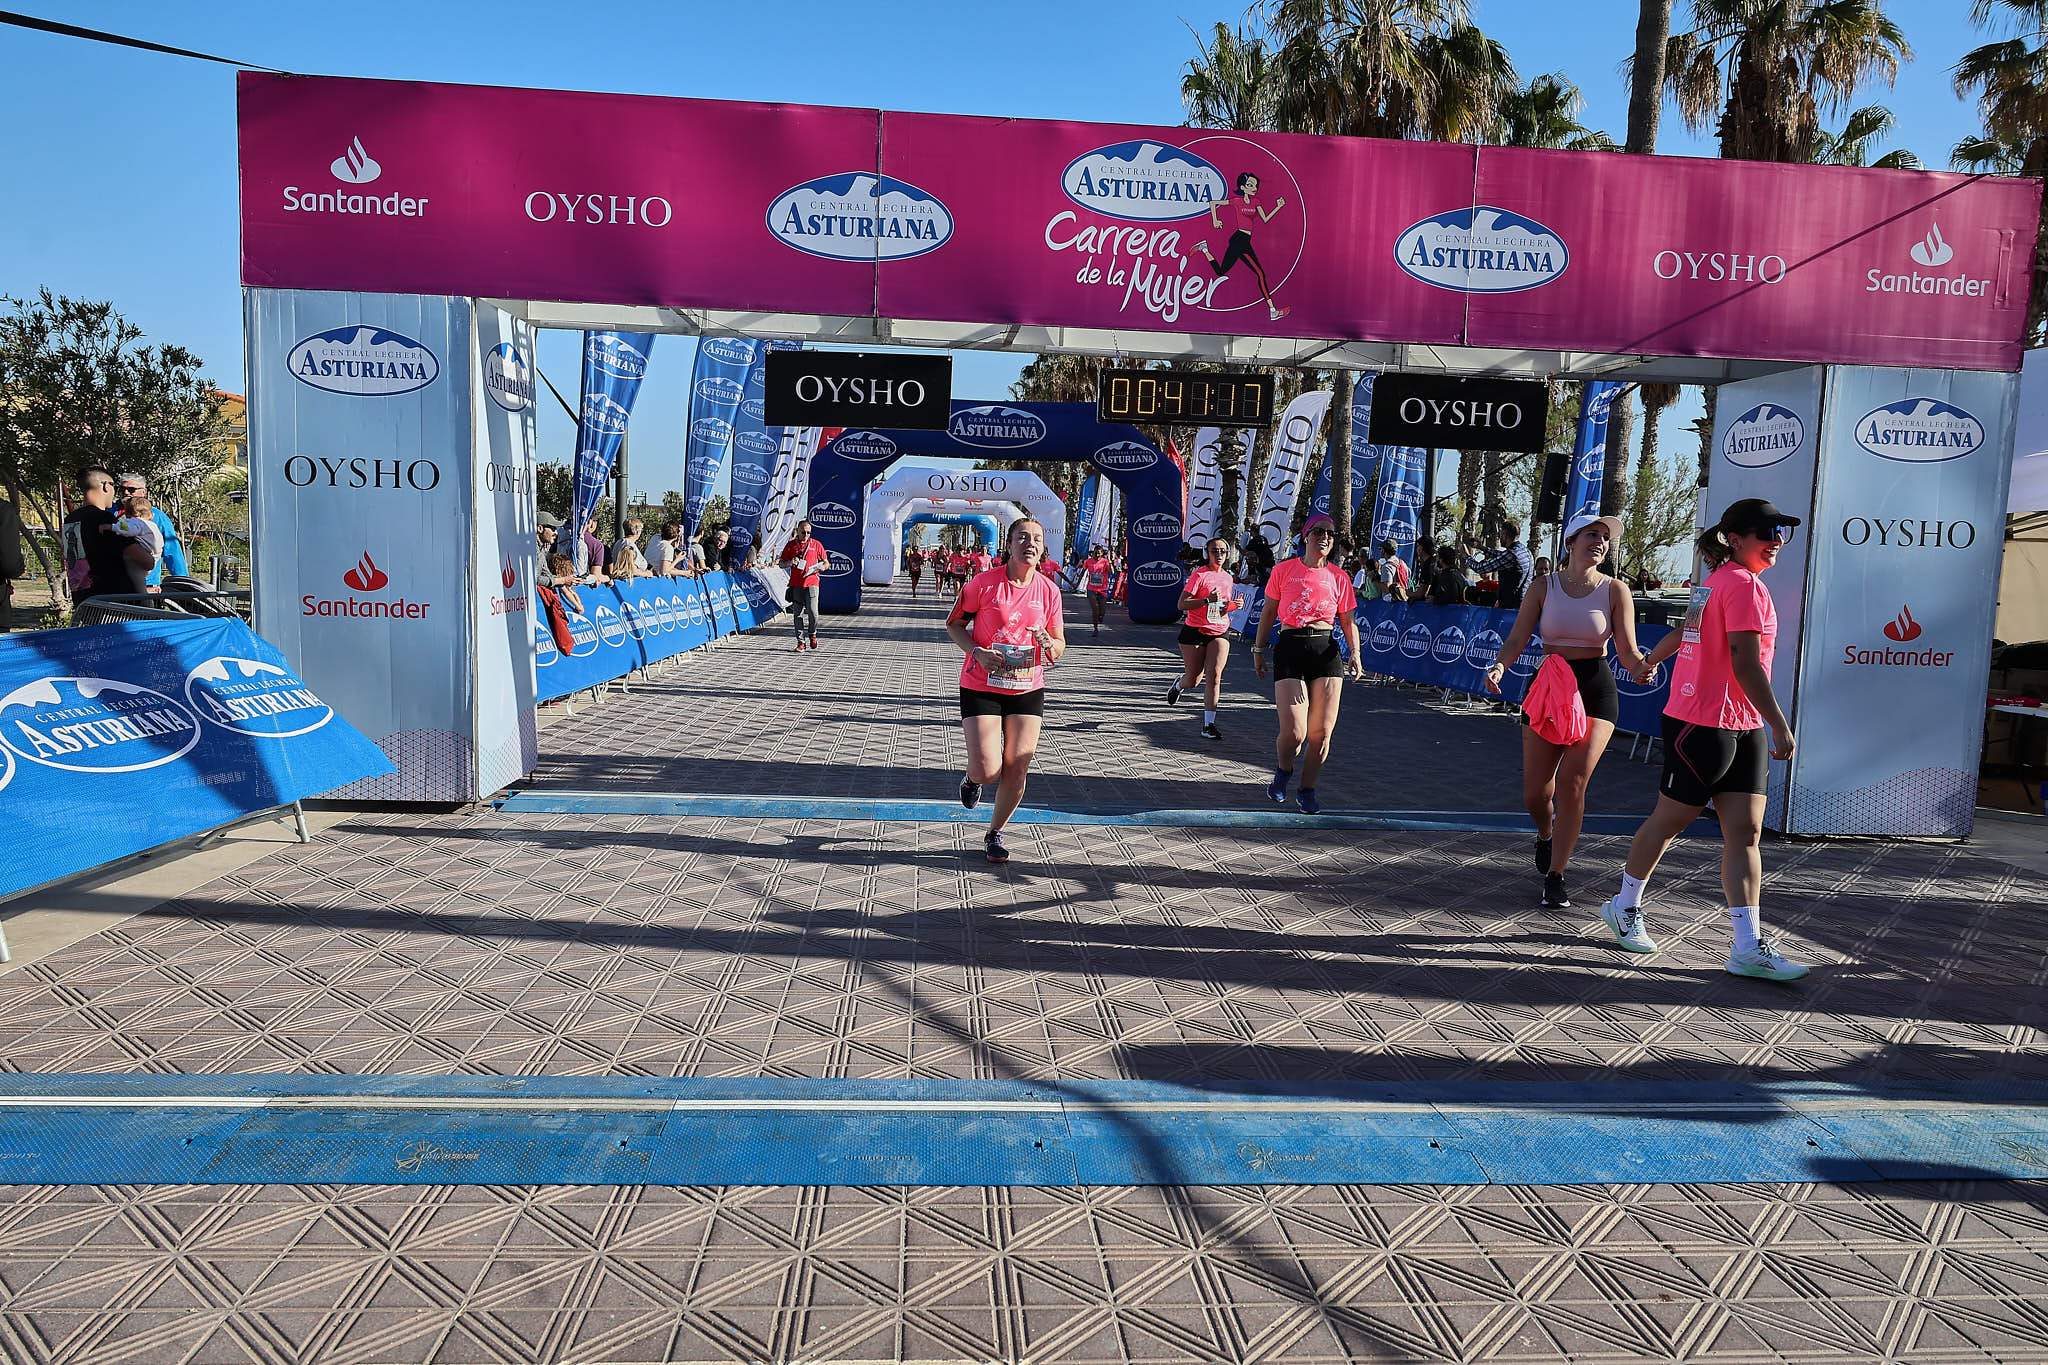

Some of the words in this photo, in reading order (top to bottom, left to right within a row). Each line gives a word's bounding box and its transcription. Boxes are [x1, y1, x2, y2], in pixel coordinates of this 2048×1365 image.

[1074, 166, 1213, 203] ASTURIANA
[1100, 165, 1152, 177] CENTRAL
[1157, 168, 1211, 180] LECHERA
[283, 185, 429, 218] Santander
[525, 191, 672, 227] OYSHO
[810, 201, 869, 212] CENTRAL
[781, 202, 939, 240] ASTURIANA
[1045, 210, 1182, 259] Carrera
[1407, 235, 1555, 273] ASTURIANA
[1435, 234, 1490, 245] CENTRAL
[1495, 237, 1551, 248] LECHERA
[1653, 249, 1787, 285] OYSHO
[1076, 256, 1102, 285] de
[1107, 256, 1125, 286] la
[1119, 255, 1229, 323] Mujer
[1865, 268, 1991, 298] Santander
[299, 350, 428, 380] ASTURIANA
[322, 349, 370, 358] CENTRAL
[375, 351, 423, 360] LECHERA
[795, 375, 925, 407] OYSHO
[1111, 378, 1261, 417] 00:41:17
[953, 417, 1039, 439] ASTURIANA
[1400, 397, 1522, 429] OYSHO
[1884, 419, 1926, 427] CENTRAL
[1930, 421, 1972, 429] LECHERA
[837, 441, 891, 455] ASTURIANA
[1727, 431, 1796, 455] ASTURIANA
[1863, 420, 1974, 448] ASTURIANA
[1100, 452, 1154, 464] ASTURIANA
[1390, 448, 1425, 465] ASTURIAN
[284, 455, 440, 491] OYSHO
[486, 462, 531, 496] OYSHO
[766, 433, 795, 533] OYSH
[928, 474, 1007, 493] OYSHO
[1259, 415, 1313, 547] OYSHO
[811, 511, 853, 524] ASTURIANA
[1842, 517, 1976, 549] OYSHO
[302, 594, 431, 619] Santander
[491, 596, 529, 616] Santander
[1844, 645, 1954, 667] Santander
[214, 683, 258, 695] CENTRAL
[35, 705, 102, 723] CENTRAL
[101, 697, 162, 711] LECHERA
[201, 688, 325, 723] ASTURIANA
[15, 708, 193, 759] ASTURIANA
